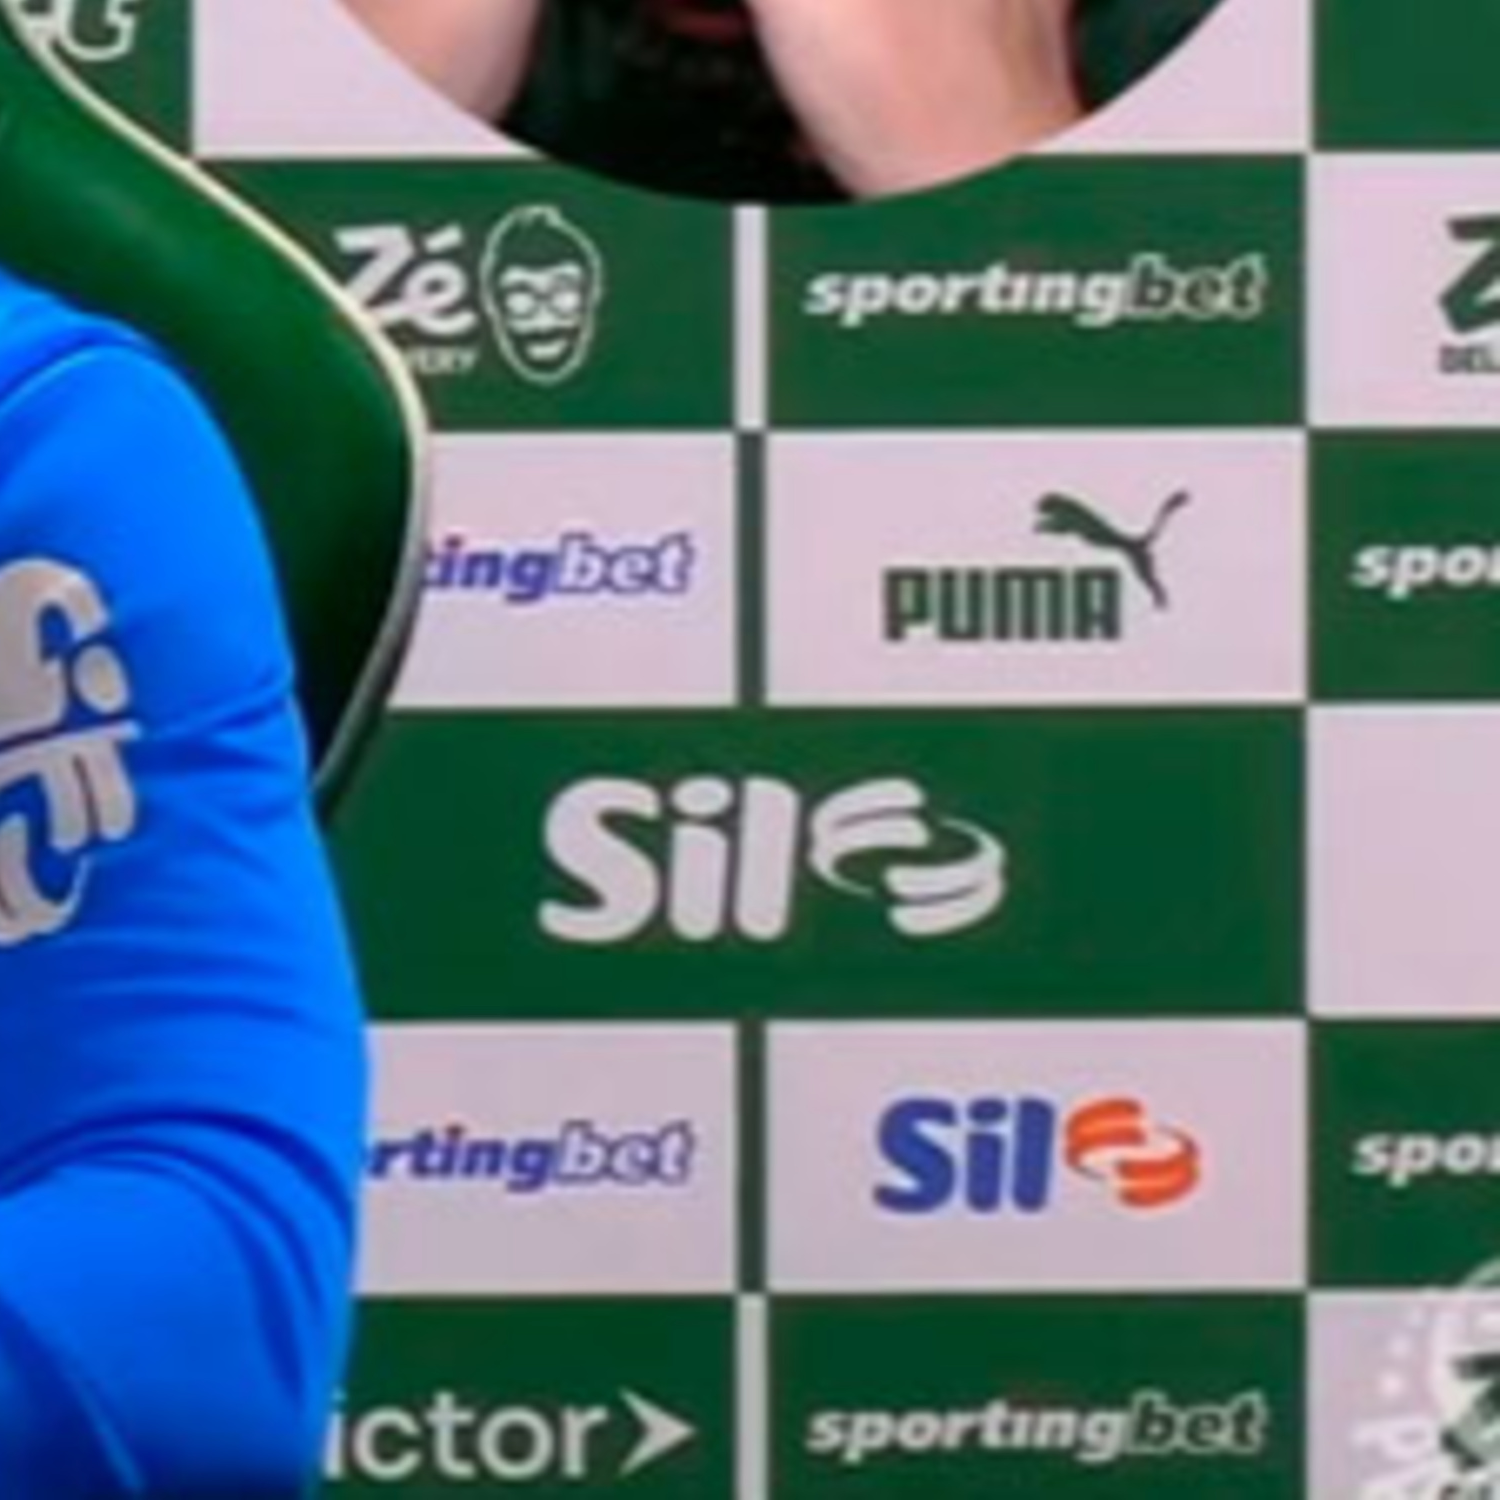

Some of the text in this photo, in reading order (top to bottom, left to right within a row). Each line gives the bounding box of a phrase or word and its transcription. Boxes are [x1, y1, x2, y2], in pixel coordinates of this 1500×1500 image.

[803, 252, 1268, 327] sportingbet
[881, 566, 1122, 642] PUMA
[1350, 542, 1500, 598] spo
[538, 776, 801, 942] Sil
[872, 1096, 1056, 1213] Sil
[1352, 1132, 1500, 1187] spo
[804, 1390, 1268, 1463] sportingbet
